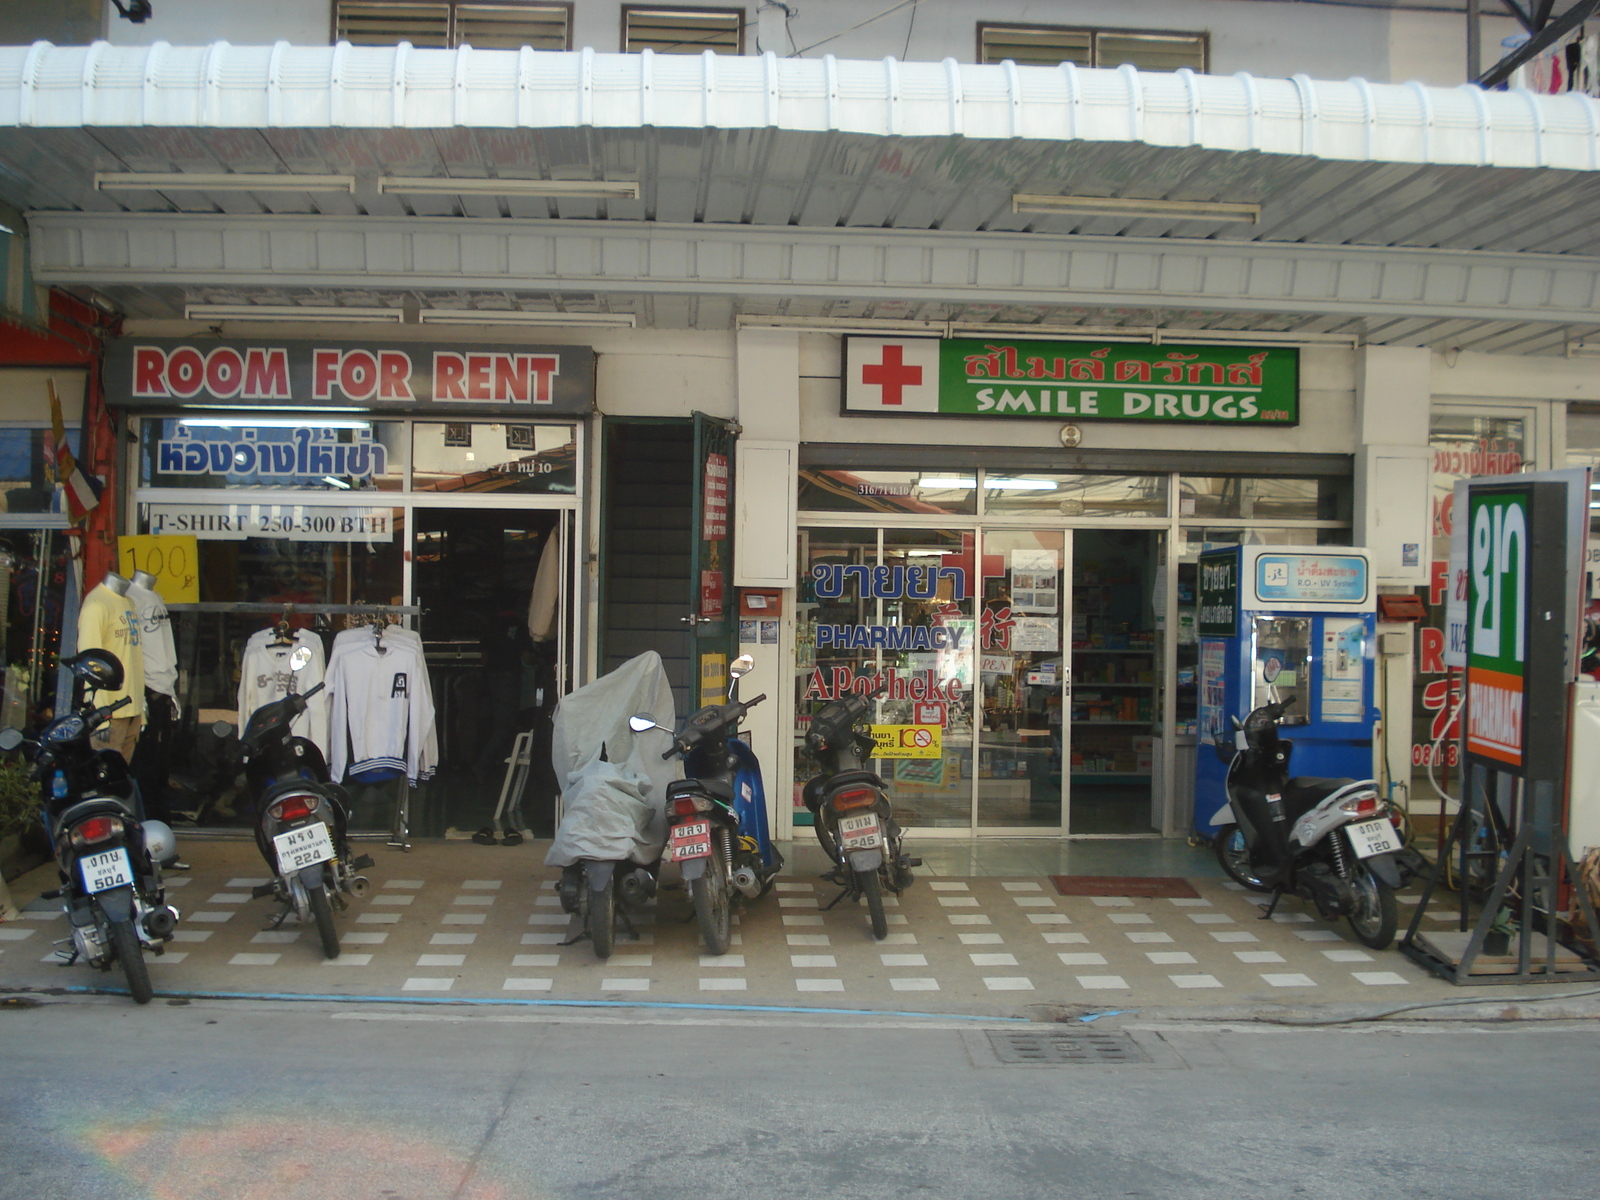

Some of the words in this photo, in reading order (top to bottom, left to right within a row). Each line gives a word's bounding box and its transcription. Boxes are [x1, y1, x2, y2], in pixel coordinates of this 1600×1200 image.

[132, 345, 292, 400] ROOM
[312, 348, 416, 402] FOR
[432, 351, 560, 405] RENT
[976, 388, 1099, 415] SMILE
[1123, 391, 1259, 419] DRUGS
[157, 425, 388, 478] ห้องว่างให้เช่า
[538, 463, 552, 474] 10
[858, 485, 888, 496] 316/71
[154, 514, 248, 533] T-SHIRT
[260, 516, 336, 534] 250-300
[340, 517, 387, 534] BTH
[127, 545, 187, 579] 100
[812, 564, 966, 601] ขายยา
[1320, 580, 1332, 588] UV
[1472, 502, 1527, 663] ยา
[816, 624, 965, 650] PHARMACY
[981, 658, 1008, 672] PEN
[850, 835, 875, 847] 245
[1367, 841, 1391, 853] 120
[294, 849, 321, 866] 224
[679, 844, 704, 857] 445
[94, 873, 125, 890] 504
